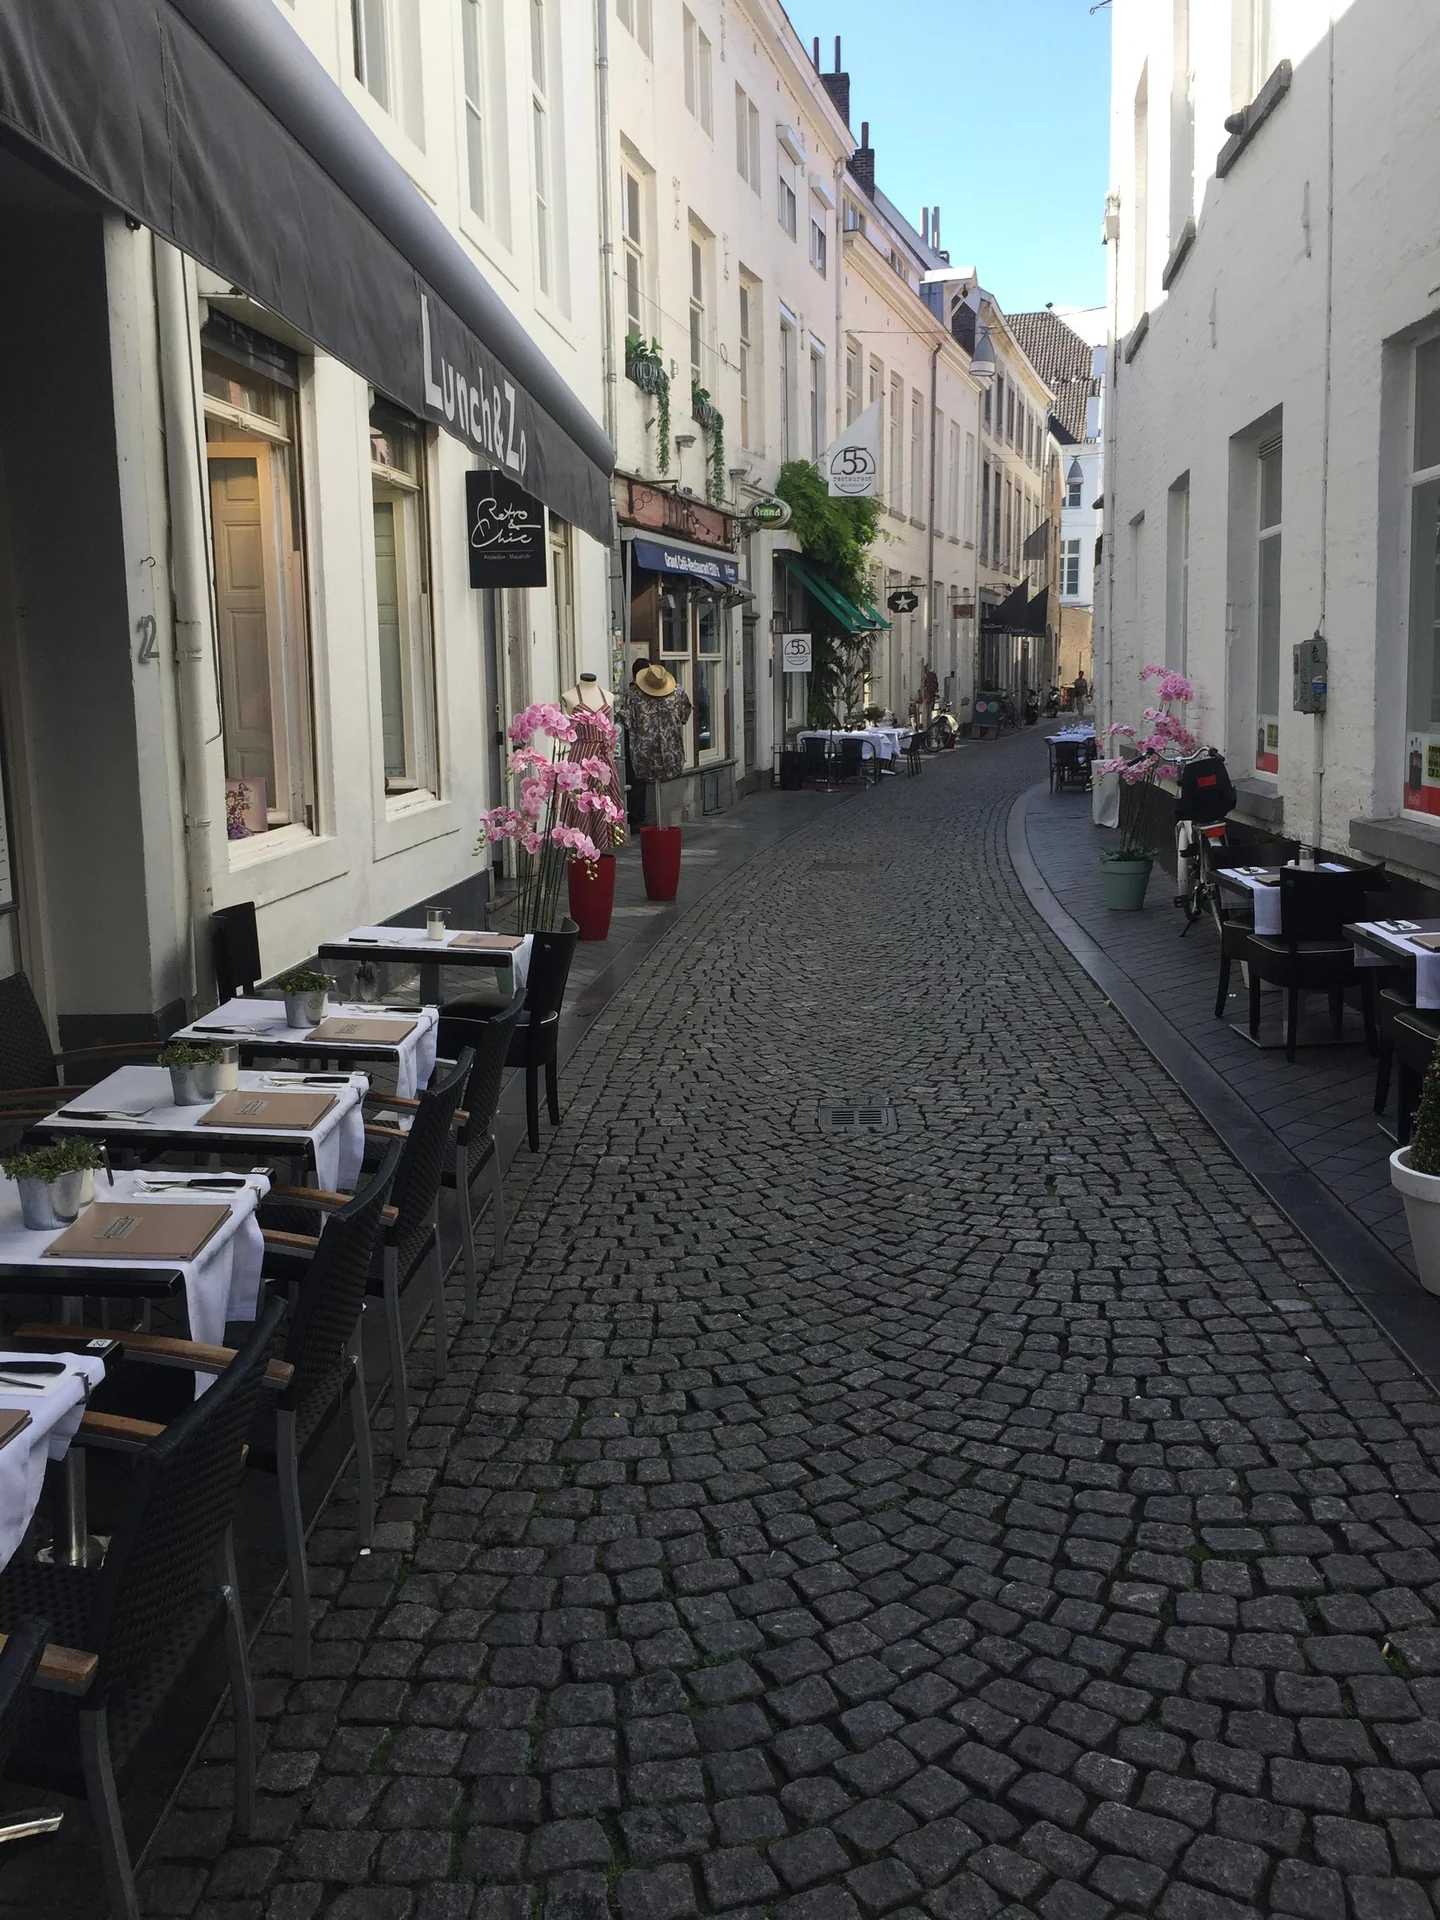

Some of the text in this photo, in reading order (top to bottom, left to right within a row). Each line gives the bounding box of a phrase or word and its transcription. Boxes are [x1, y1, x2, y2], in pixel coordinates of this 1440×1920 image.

[841, 447, 868, 475] 55
[476, 498, 529, 538] Retro
[753, 506, 781, 517] Brand
[471, 518, 532, 548] Chic
[791, 640, 806, 655] 55
